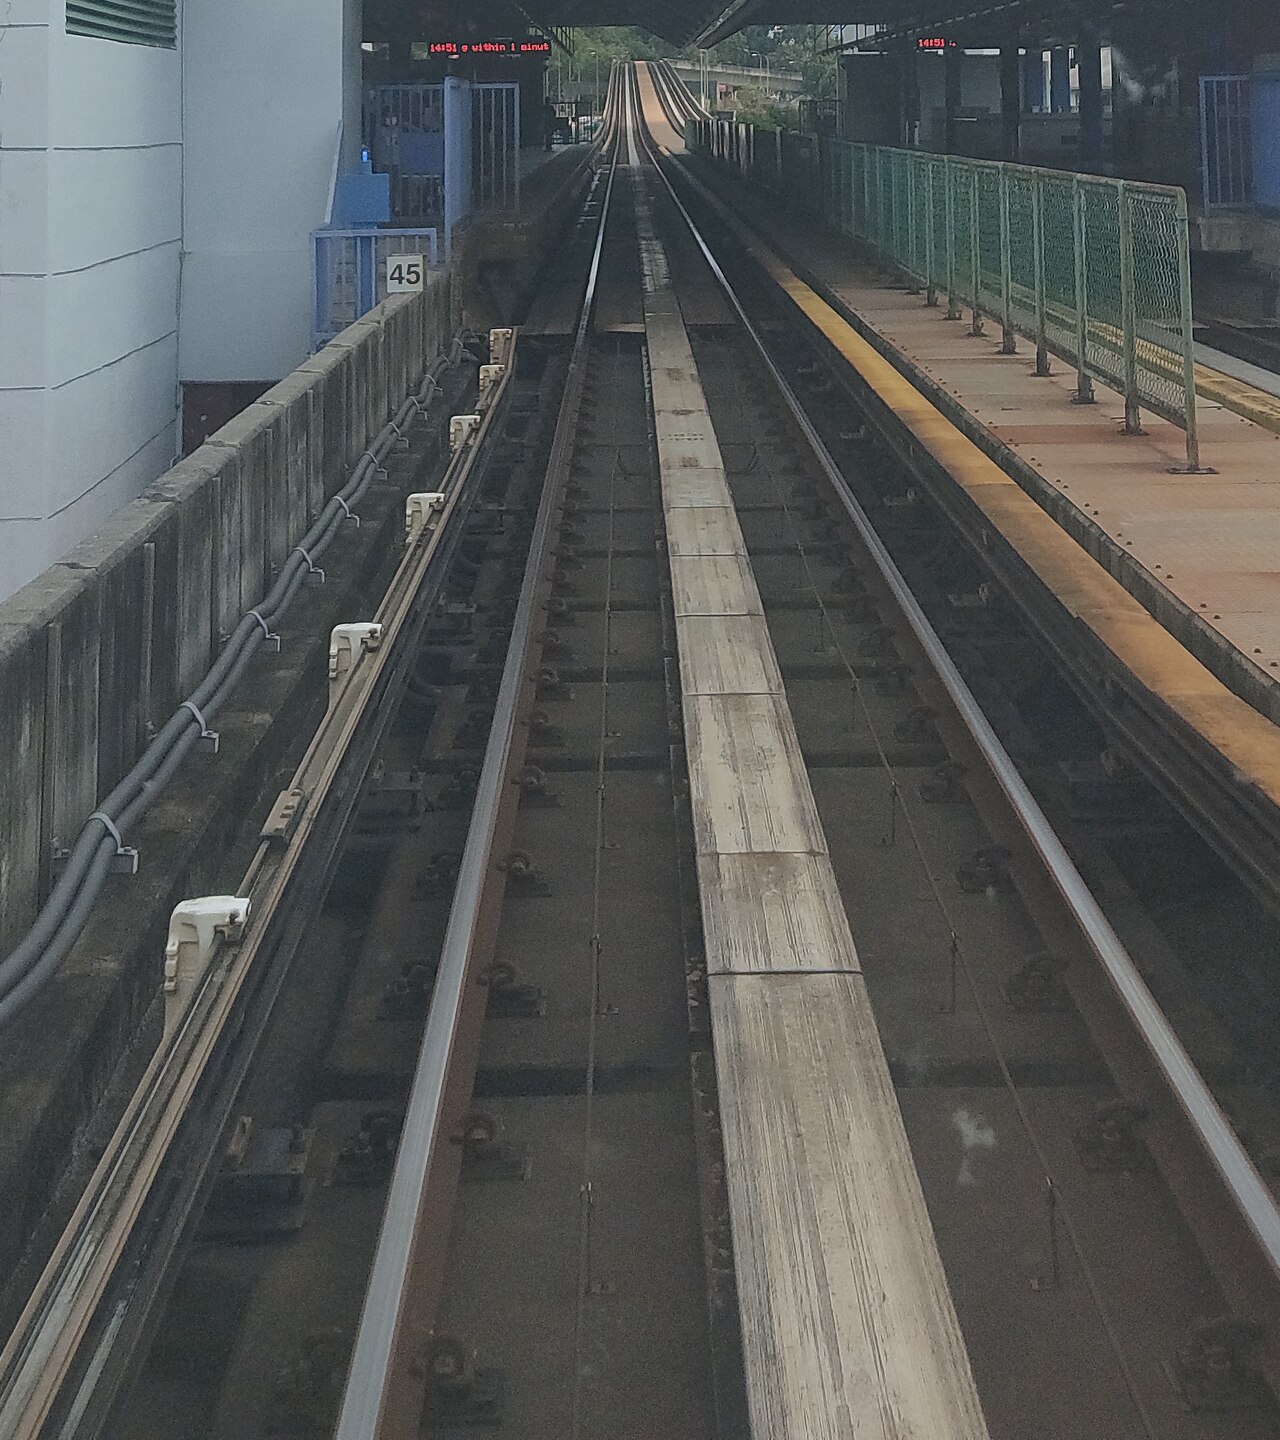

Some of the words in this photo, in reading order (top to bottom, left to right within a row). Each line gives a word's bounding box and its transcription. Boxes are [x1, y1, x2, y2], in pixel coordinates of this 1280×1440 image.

[430, 43, 457, 52] 14:51
[471, 43, 506, 52] within
[511, 43, 516, 51] 1
[918, 39, 945, 47] 14:51
[389, 263, 420, 284] 45
